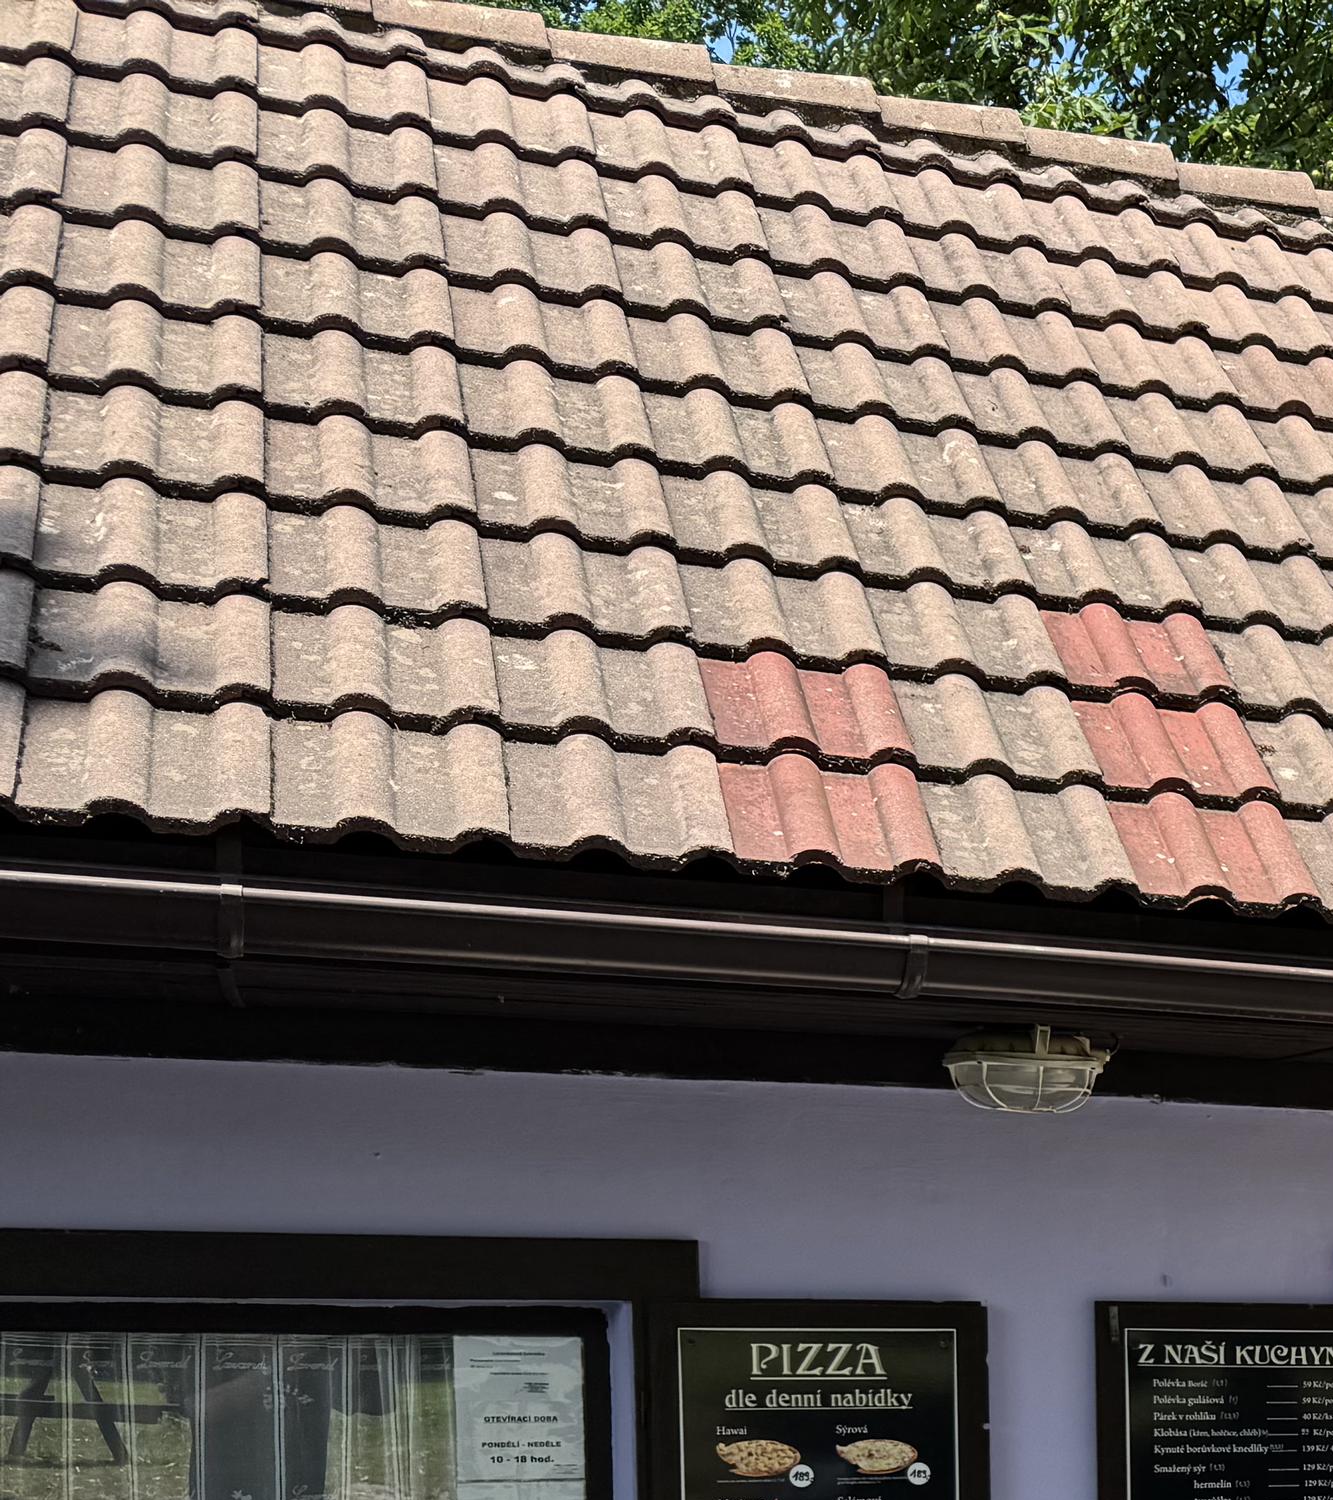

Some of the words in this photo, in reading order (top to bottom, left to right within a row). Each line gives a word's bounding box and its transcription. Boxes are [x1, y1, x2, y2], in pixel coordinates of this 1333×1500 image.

[1138, 1344, 1155, 1364] Z
[1165, 1341, 1226, 1365] NAŠÍ
[750, 1342, 888, 1376] PIZZA
[724, 1388, 758, 1408] dle
[765, 1388, 822, 1407] denní
[831, 1388, 913, 1410] nabídky
[716, 1425, 748, 1436] Hawai
[1154, 1428, 1187, 1437] Klobása
[1232, 1443, 1269, 1454] knedlíky
[531, 1455, 554, 1463] hod.
[1194, 1480, 1232, 1489] hermelín
